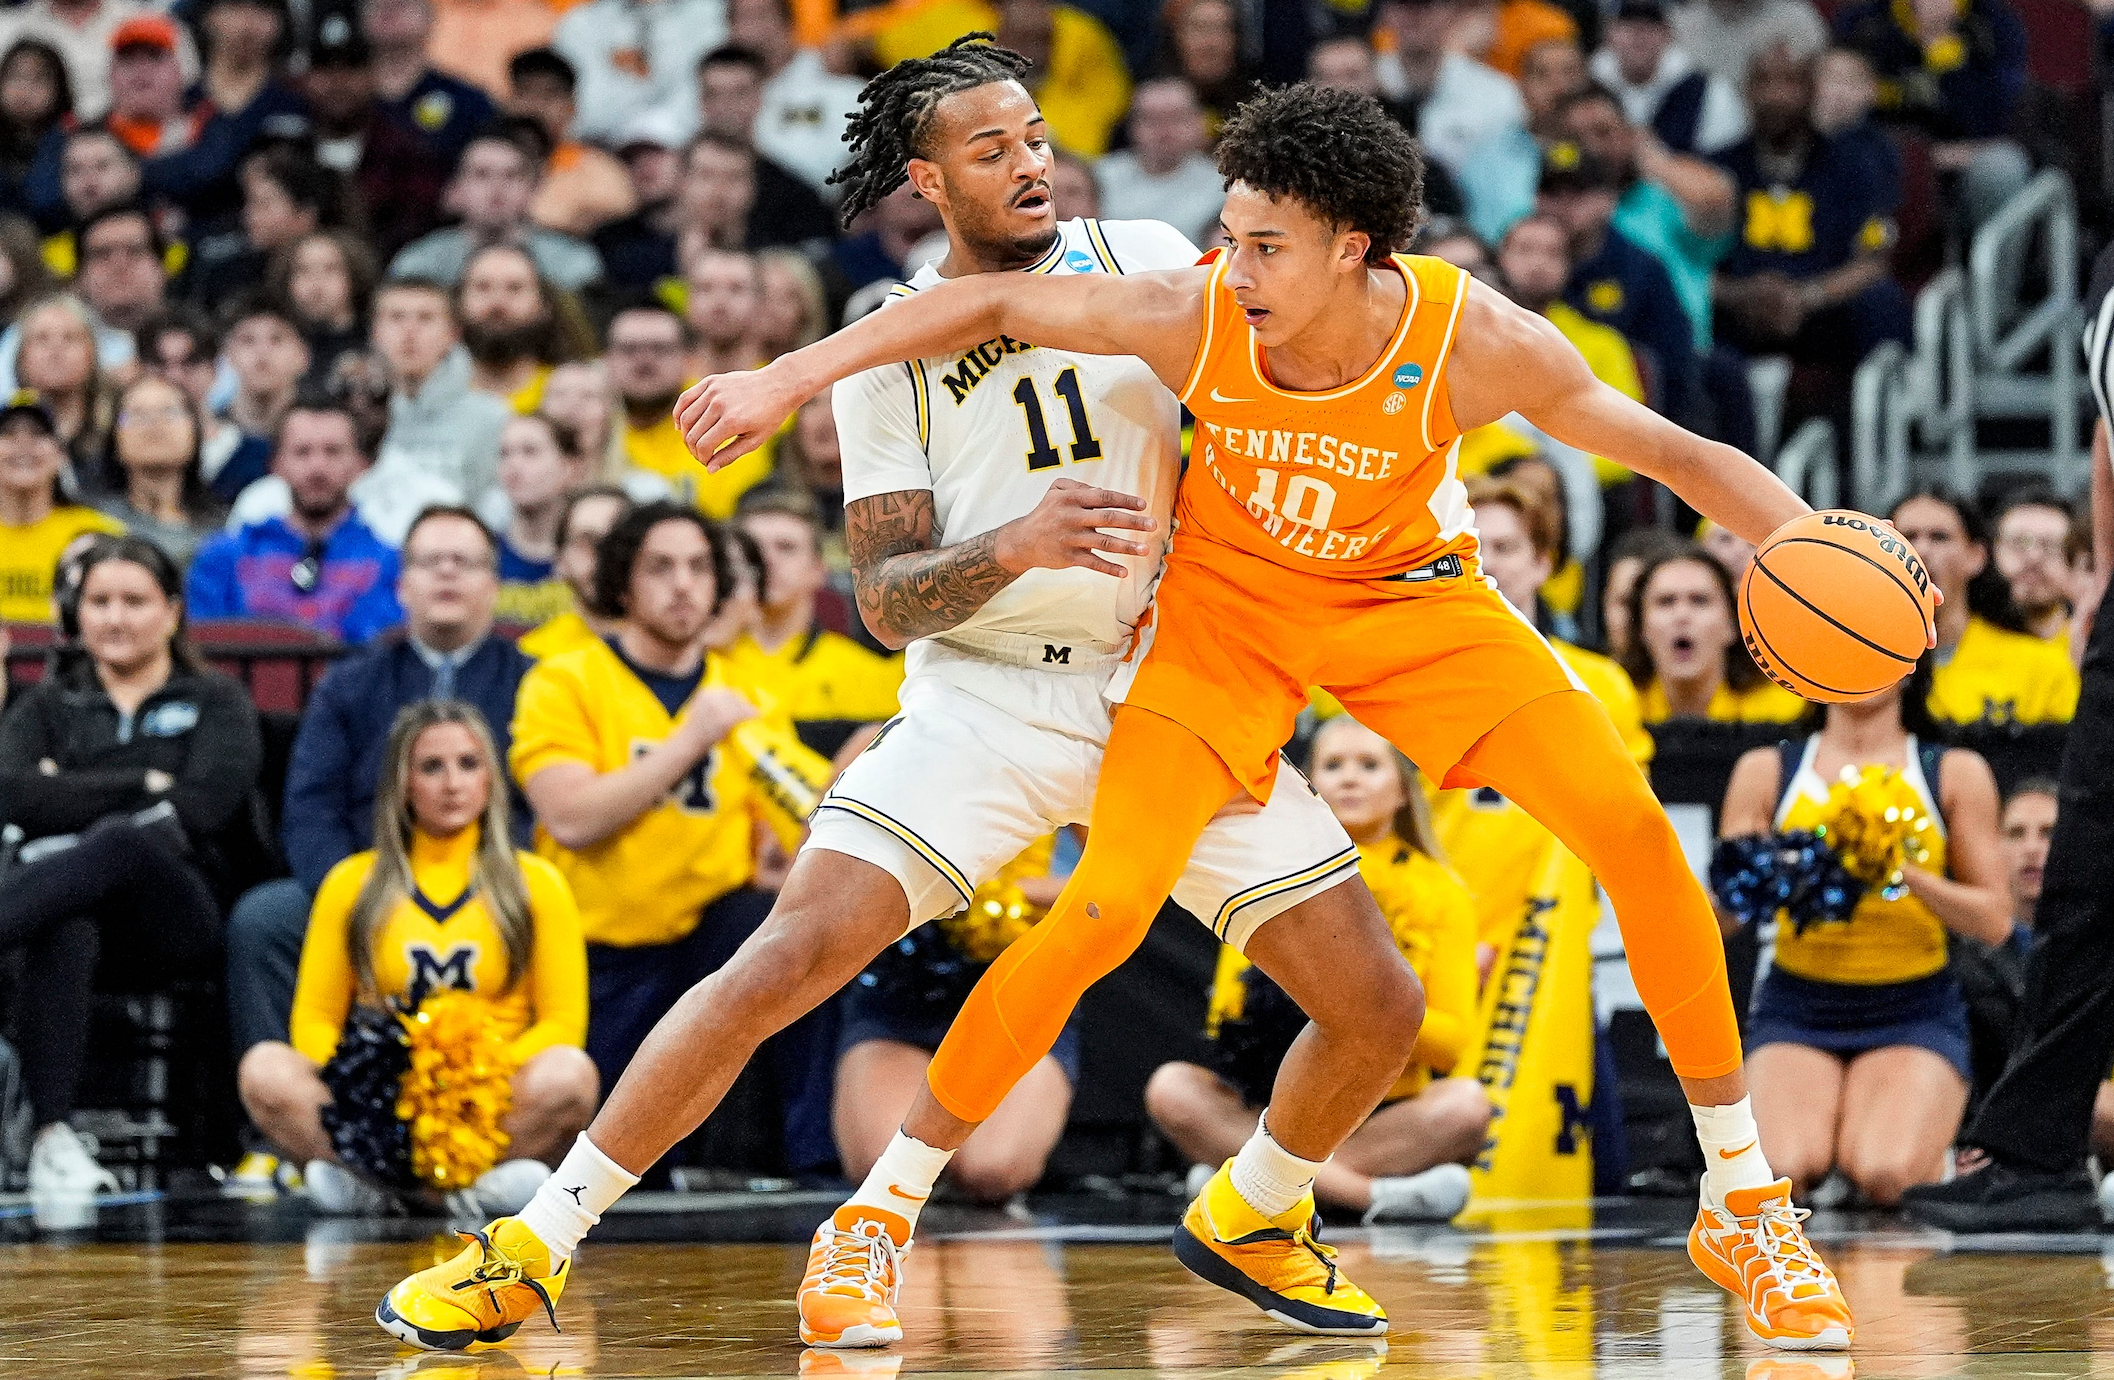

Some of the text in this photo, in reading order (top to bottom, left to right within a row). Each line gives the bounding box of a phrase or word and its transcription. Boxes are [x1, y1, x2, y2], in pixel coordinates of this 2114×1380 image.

[940, 334, 1036, 408] MICH
[1395, 374, 1420, 384] NCAA
[1011, 365, 1103, 473] 11
[1384, 393, 1405, 413] SEC
[1205, 421, 1398, 481] TENNESSEE
[1249, 468, 1337, 530] 10
[1437, 560, 1450, 571] 48
[1822, 515, 1928, 598] Wilson
[1042, 644, 1072, 665] M
[407, 946, 475, 992] M
[1473, 898, 1559, 1172] MICHIG
